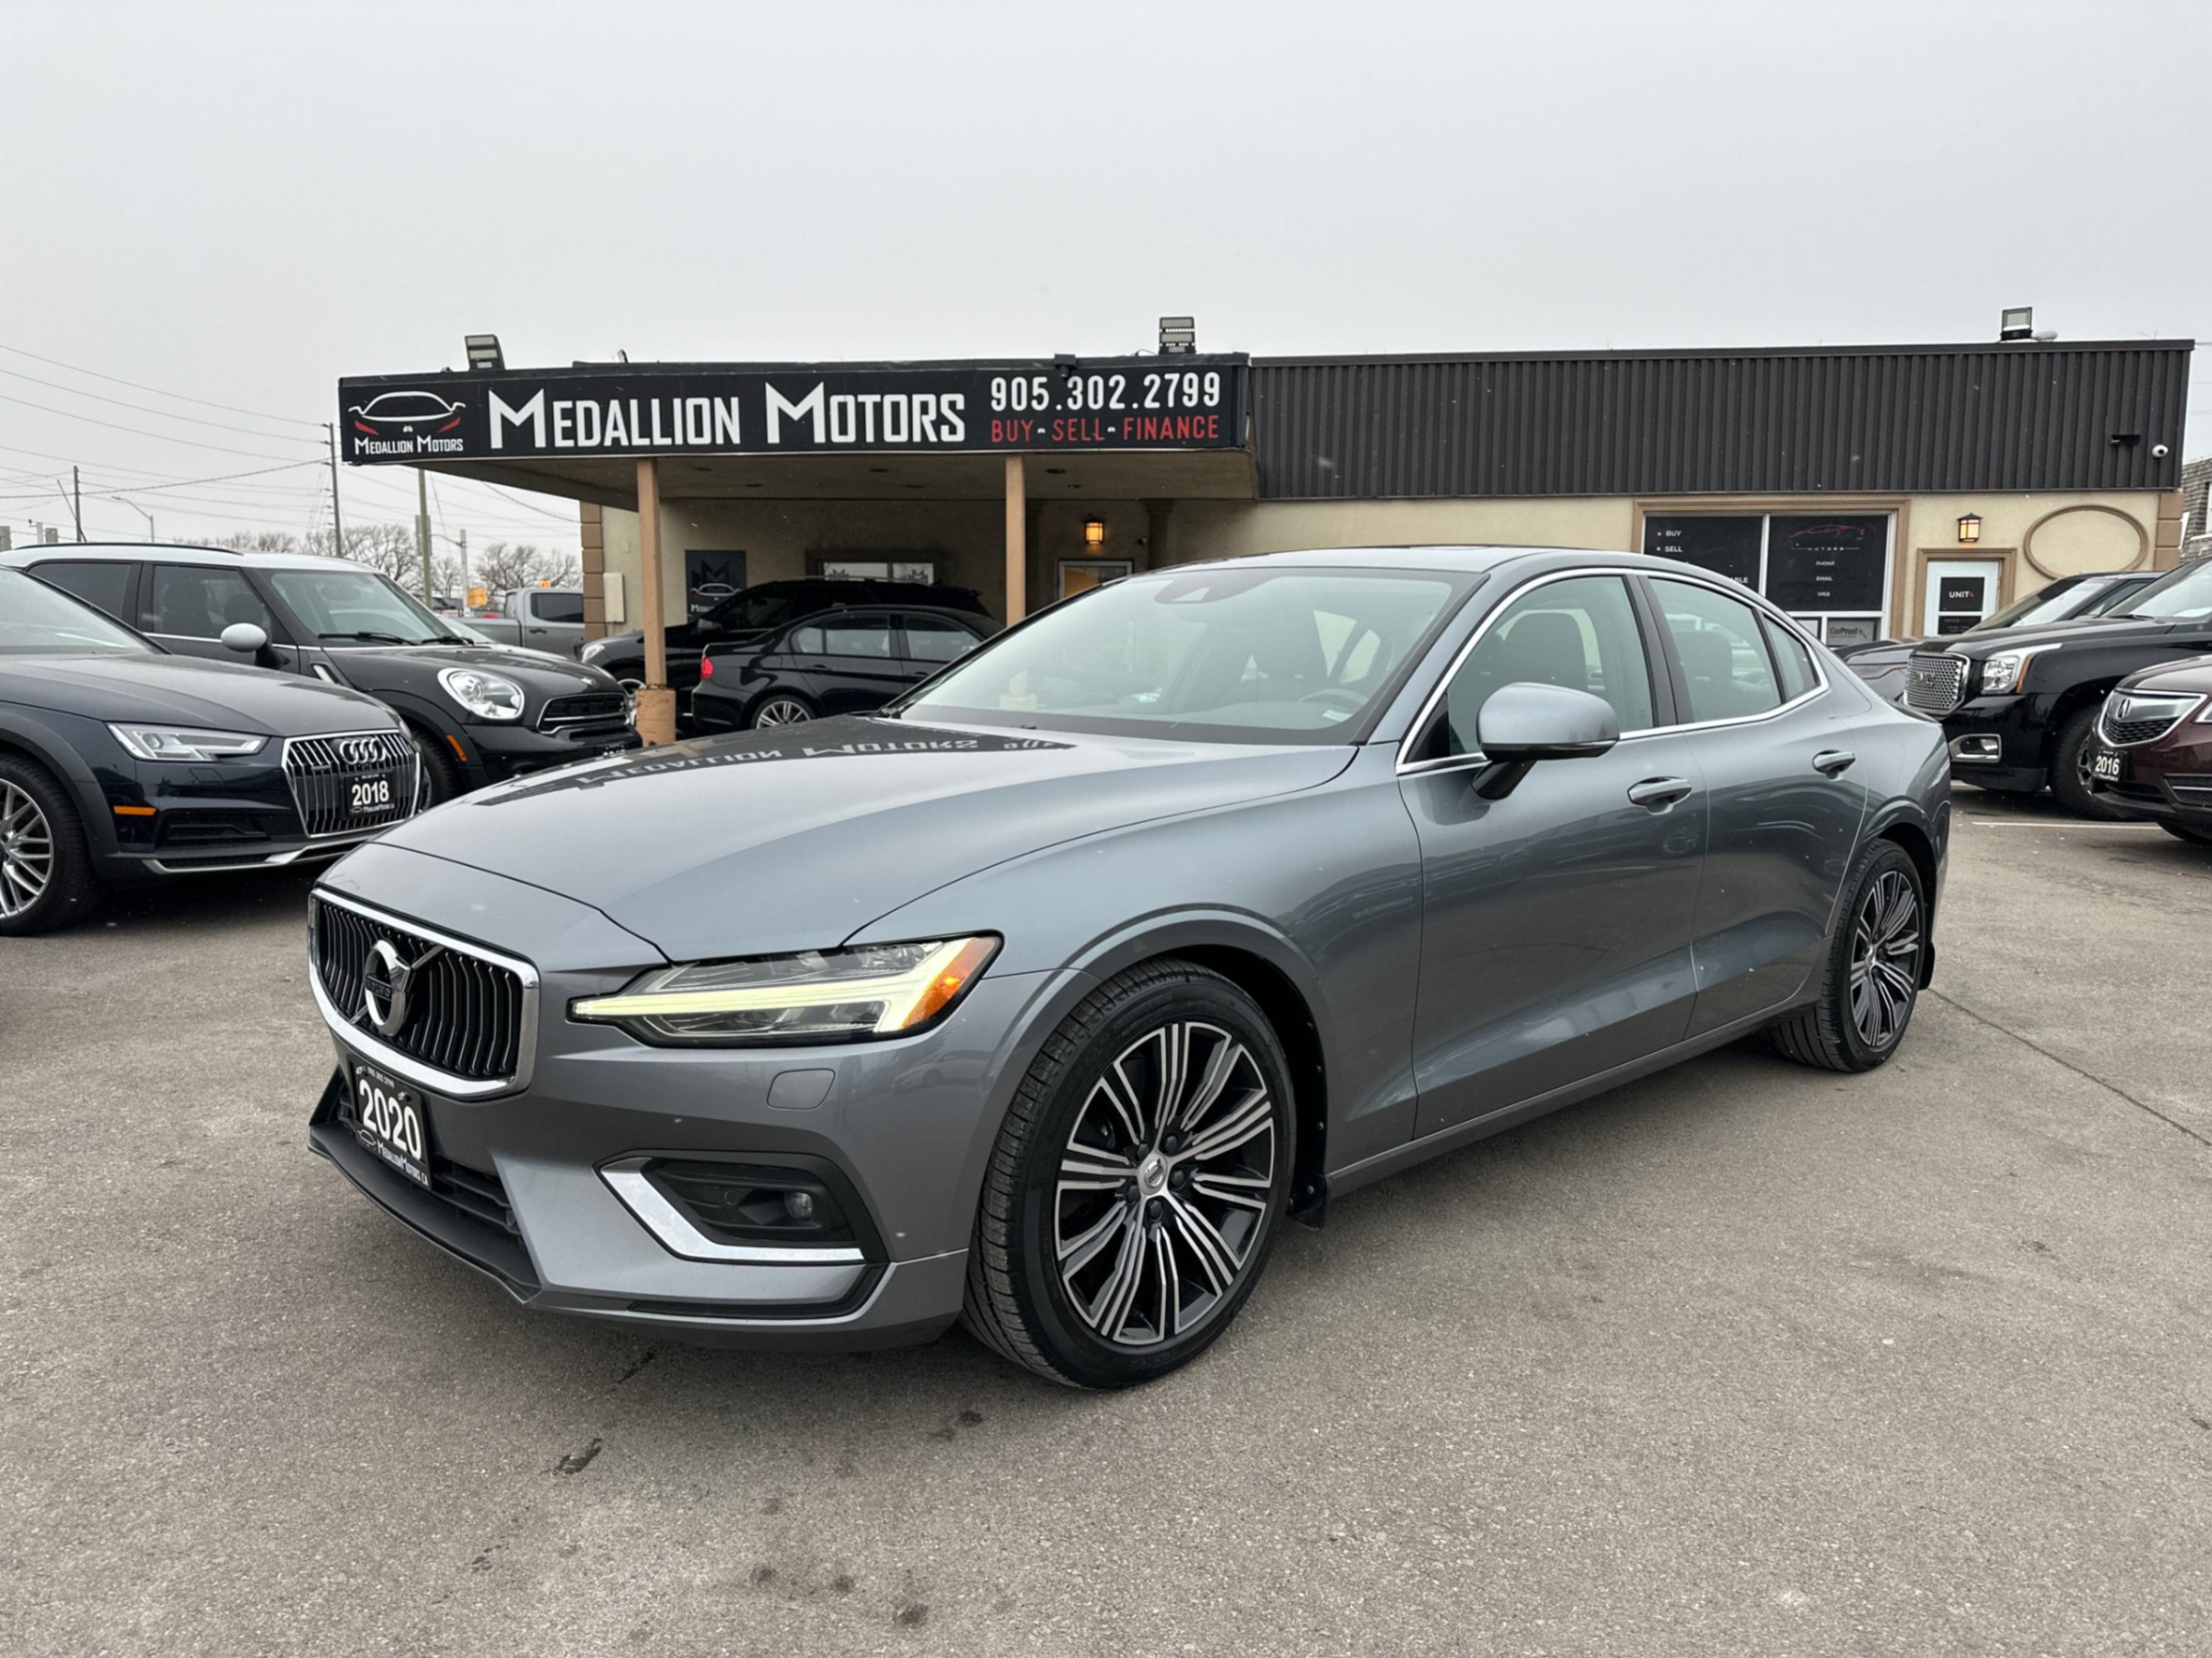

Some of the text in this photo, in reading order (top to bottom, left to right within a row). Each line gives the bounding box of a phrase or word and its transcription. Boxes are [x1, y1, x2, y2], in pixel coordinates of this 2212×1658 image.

[991, 372, 1220, 411] 905.302.2799
[488, 381, 965, 449] MEDALLION MOTORS
[991, 415, 1219, 443] BUY SELL FINANCE
[354, 434, 464, 455] MEDALLION MOTORS
[2094, 755, 2120, 775] 2016
[351, 780, 390, 806] 2018
[359, 1079, 422, 1161] 2020
